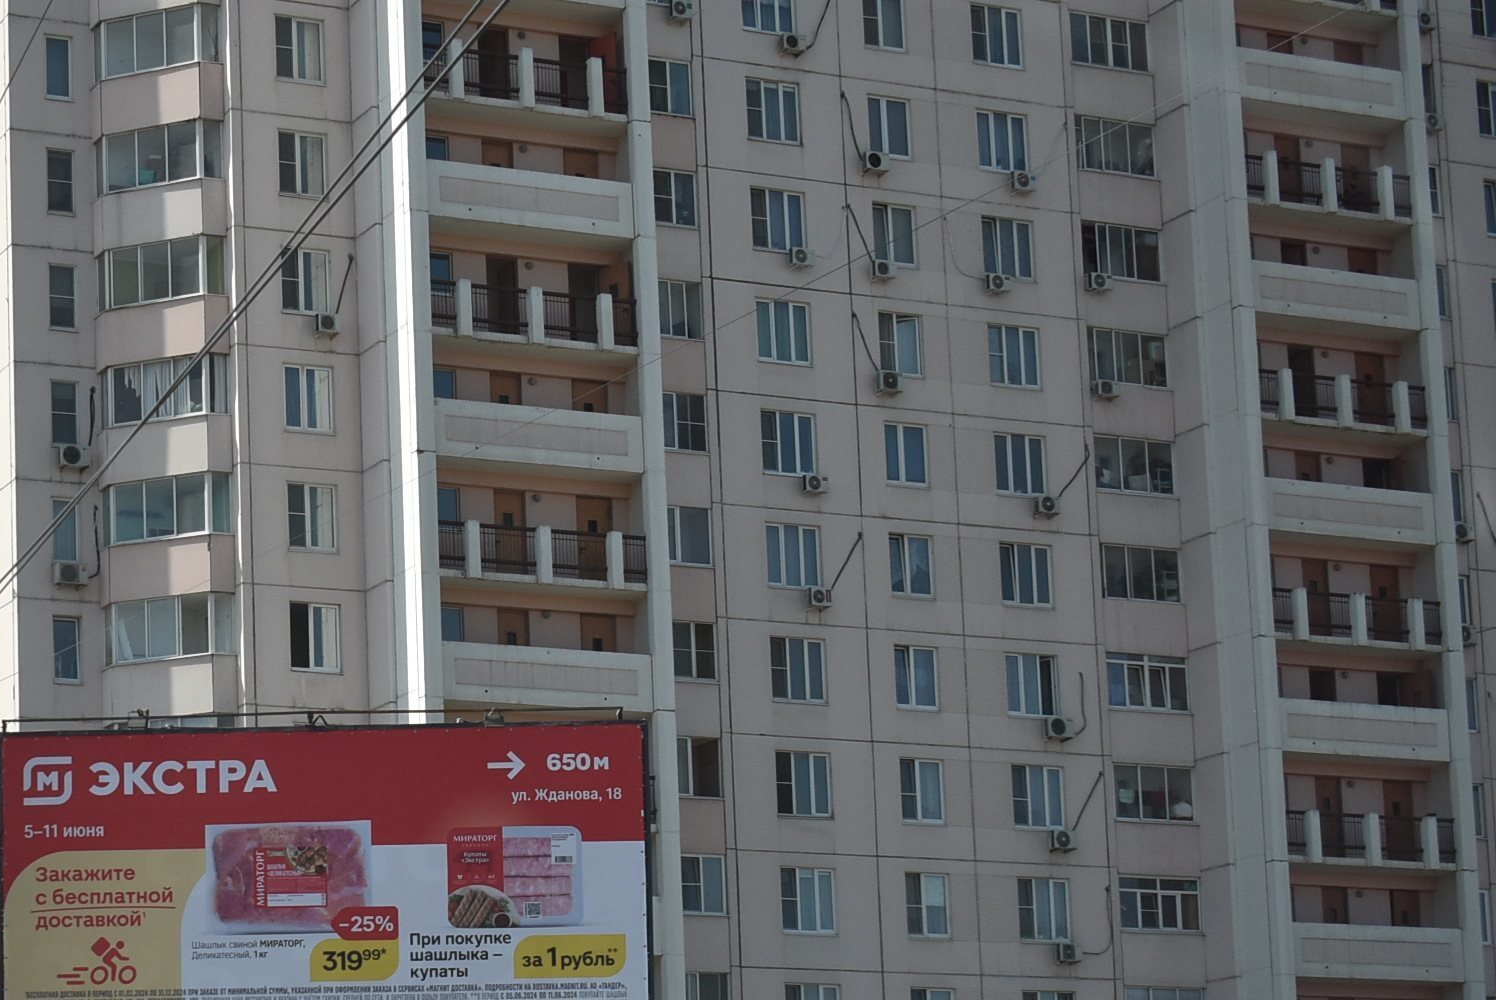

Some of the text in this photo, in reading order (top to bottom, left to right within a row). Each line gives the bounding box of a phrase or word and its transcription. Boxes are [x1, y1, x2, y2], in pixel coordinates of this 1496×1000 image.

[546, 752, 591, 771] 650
[88, 759, 278, 796] ЭКСТРА
[511, 787, 622, 804] ул. Жданова, 18
[62, 825, 105, 838] июня
[35, 866, 136, 882] Закажите
[256, 850, 266, 906] МИРАТОРГ
[35, 886, 174, 906] с бесплатной
[191, 939, 306, 950] Шашлык свиной МИРАТОРГ,
[410, 932, 512, 948] При покупке
[191, 950, 252, 961] Деликатесный,
[410, 949, 489, 962] шашлыка
[522, 955, 543, 967] за
[546, 946, 558, 966] 1
[410, 966, 468, 982] купаты
